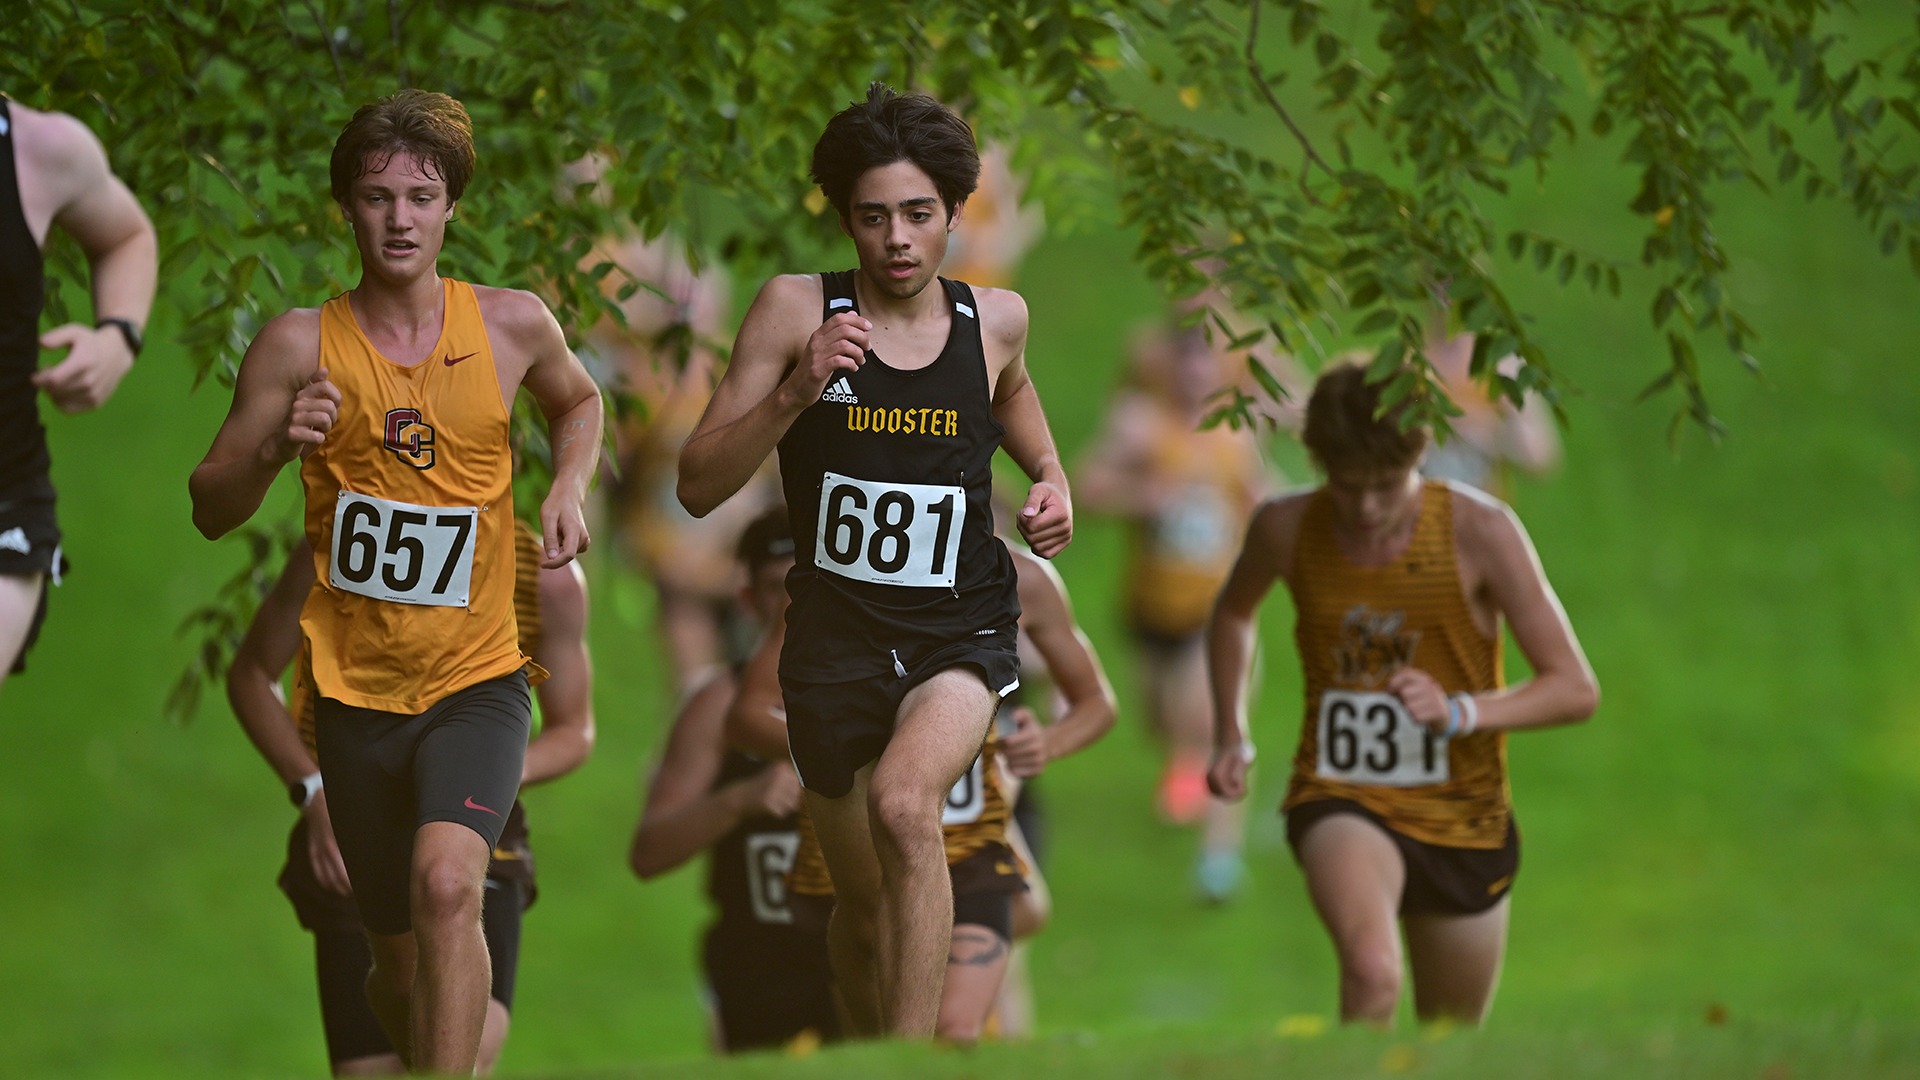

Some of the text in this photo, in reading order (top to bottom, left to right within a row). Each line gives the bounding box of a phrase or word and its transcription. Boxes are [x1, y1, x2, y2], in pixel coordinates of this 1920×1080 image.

[822, 391, 858, 404] adidas
[847, 405, 958, 436] WOOSTER
[337, 501, 472, 594] 657
[824, 484, 954, 574] 681
